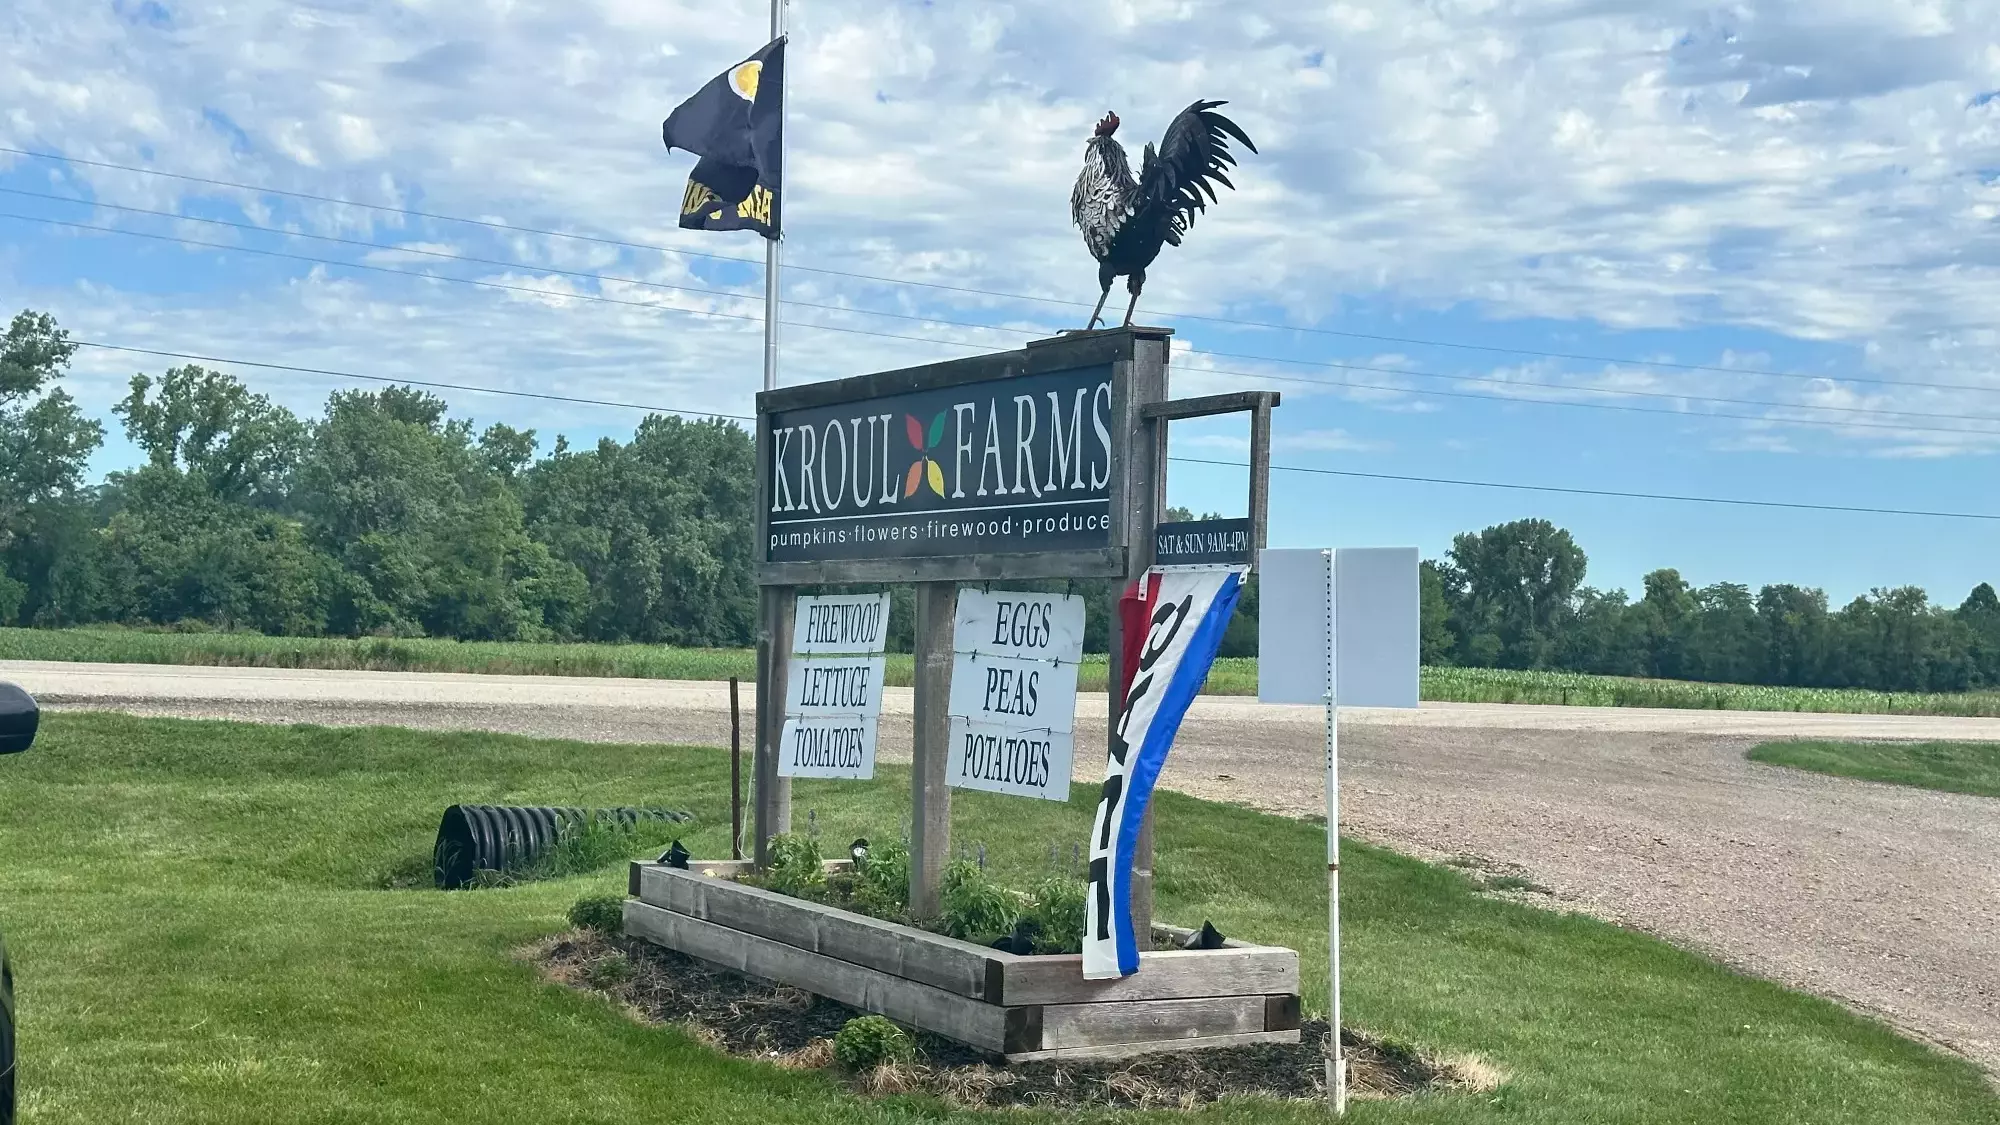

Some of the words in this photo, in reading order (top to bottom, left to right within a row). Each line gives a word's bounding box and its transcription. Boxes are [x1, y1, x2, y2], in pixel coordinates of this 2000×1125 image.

[772, 413, 900, 514] KROUL
[952, 382, 1112, 499] FARMS
[770, 527, 846, 550] pumpkins
[851, 525, 918, 542] flowers
[926, 516, 1012, 540] firewood
[1022, 512, 1110, 538] produce
[1158, 534, 1175, 555] SAT
[1175, 535, 1184, 555] &
[1185, 533, 1205, 554] SUN
[1207, 531, 1249, 553] 9AM-4PM
[805, 602, 881, 644] FIREWOOD
[992, 601, 1052, 648] EGGS
[800, 665, 870, 707] LETTUCE
[982, 667, 1039, 717] PEAS
[793, 727, 864, 769] TOMATOES
[961, 733, 1050, 788] POTATOES
